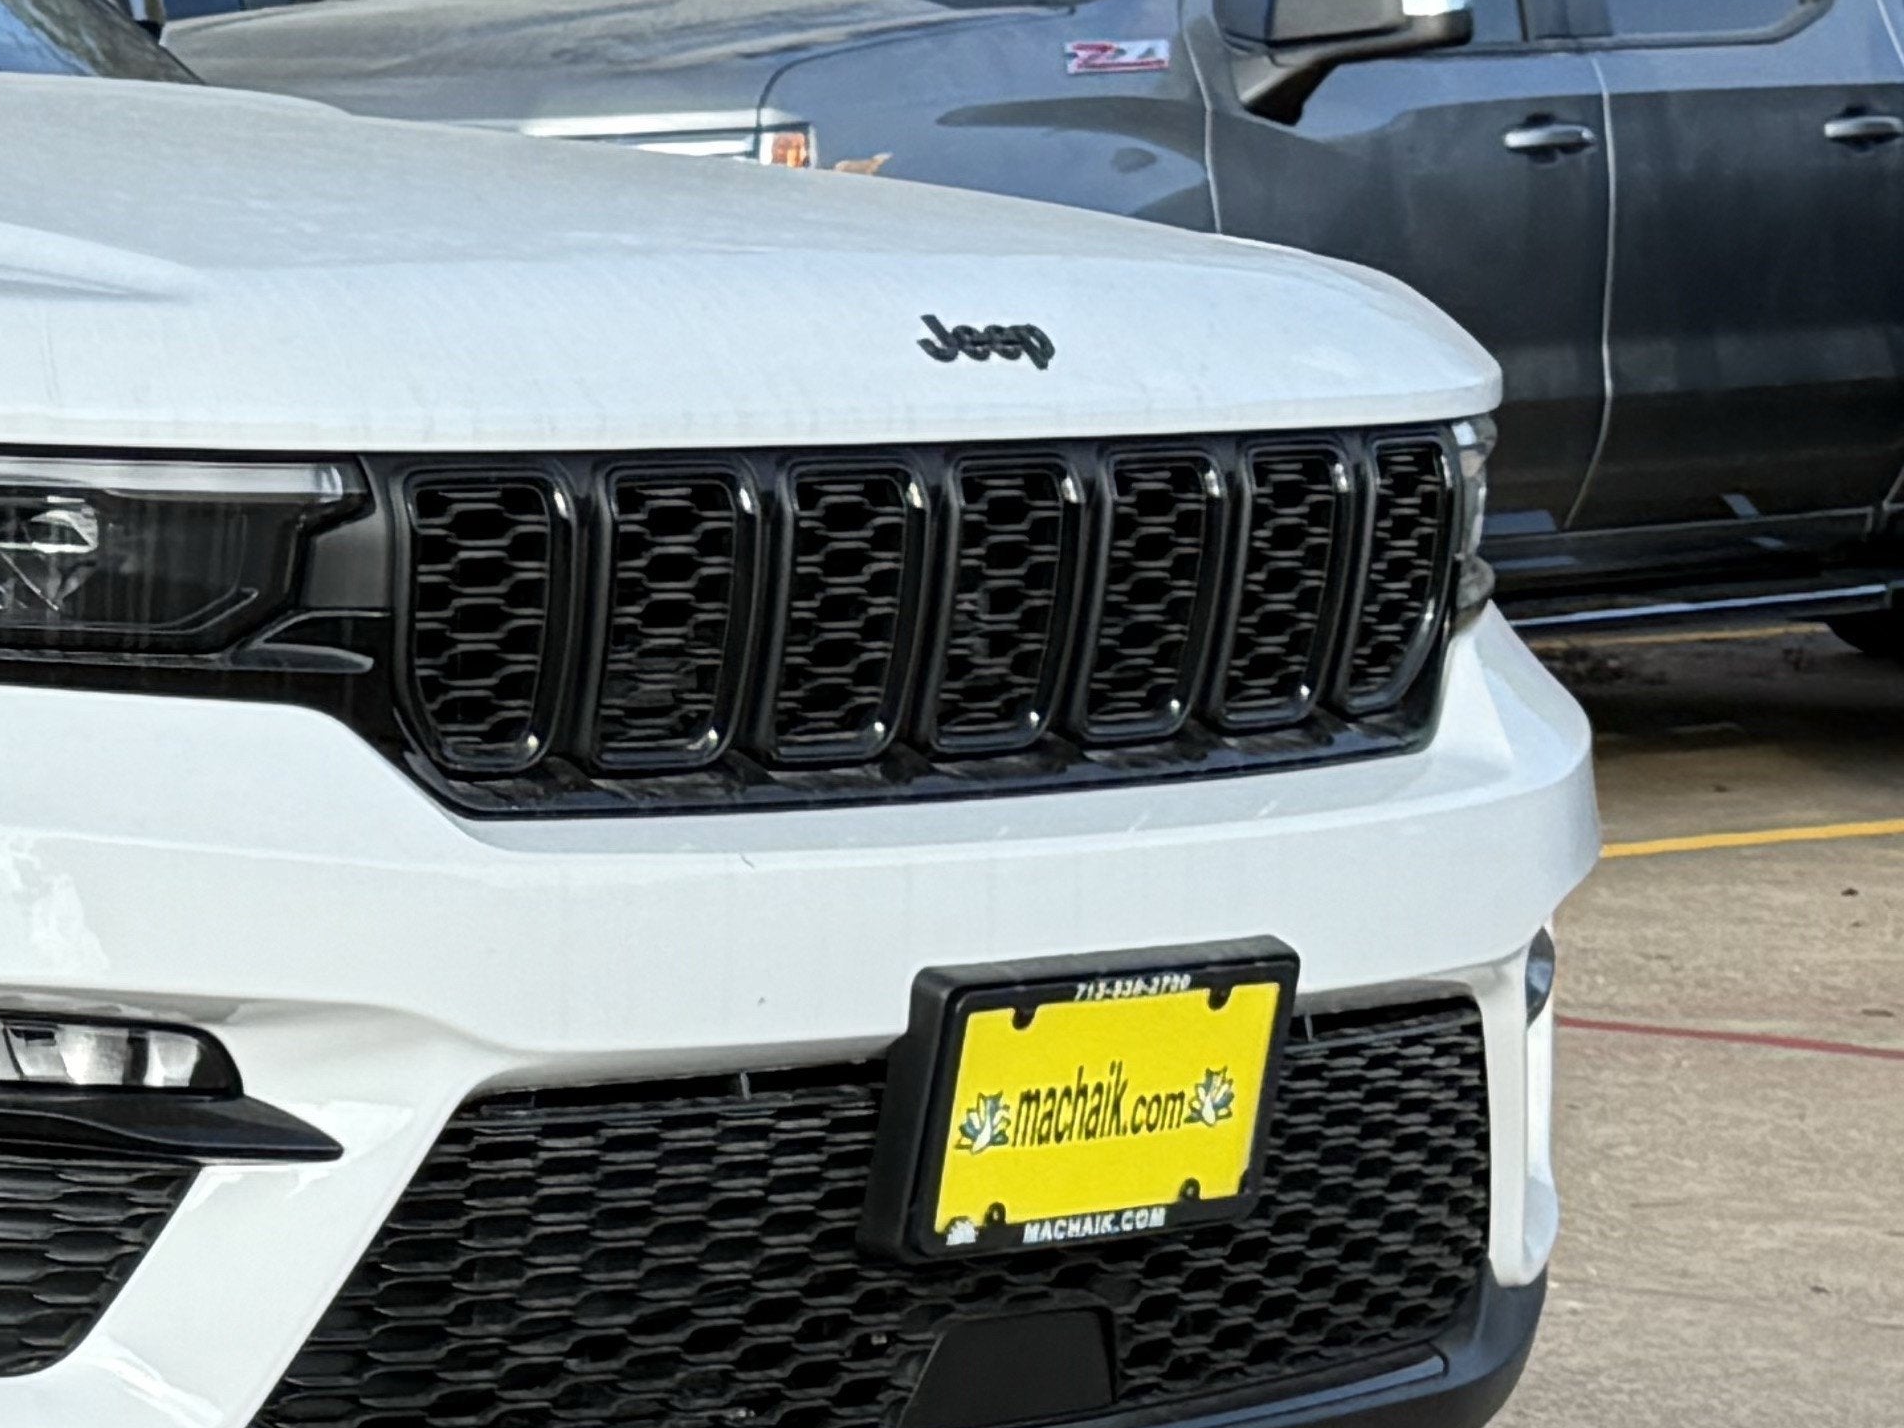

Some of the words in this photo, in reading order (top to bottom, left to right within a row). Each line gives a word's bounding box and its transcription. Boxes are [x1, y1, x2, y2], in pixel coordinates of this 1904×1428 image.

[917, 314, 1056, 371] Jeep
[1012, 1060, 1186, 1148] machaik.com
[1022, 1206, 1167, 1244] MACHAIK.COM
